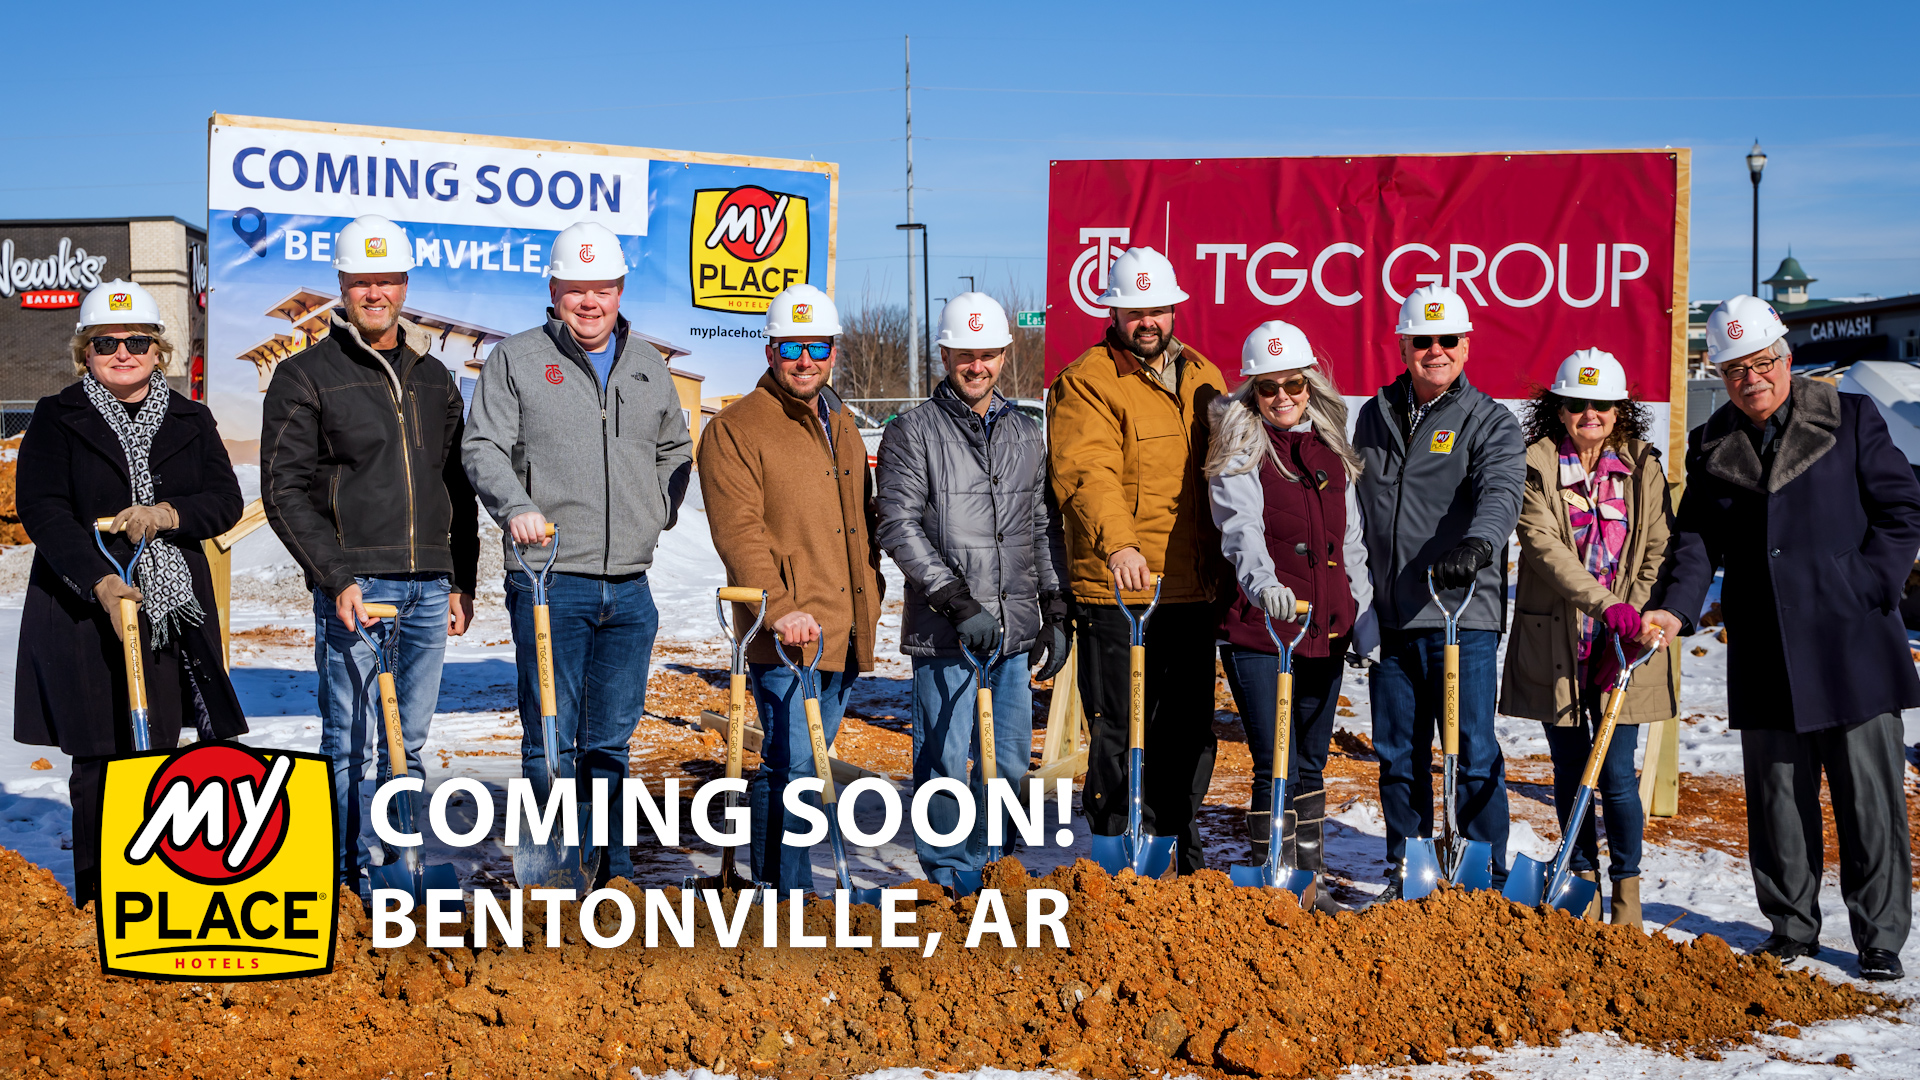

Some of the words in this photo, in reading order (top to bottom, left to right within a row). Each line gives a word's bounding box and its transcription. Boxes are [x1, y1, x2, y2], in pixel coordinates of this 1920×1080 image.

[232, 146, 460, 203] COMING
[475, 164, 621, 213] SOON
[284, 230, 549, 278] BENVILLE,
[699, 263, 799, 293] PLACE
[1196, 242, 1366, 306] TGC
[1380, 242, 1650, 308] GROUP
[26, 294, 75, 305] EATERY
[728, 300, 769, 309] HOTELS
[1810, 321, 1835, 341] CAR
[1835, 315, 1871, 338] WASH
[130, 636, 138, 655] TGC
[539, 645, 547, 663] TGC
[541, 663, 550, 689] GROUP
[1133, 683, 1141, 699] TGC
[391, 709, 400, 724] TGC
[1133, 699, 1141, 723] GROUP
[1279, 711, 1287, 729] TGC
[1447, 703, 1455, 728] GROUP
[393, 724, 403, 749] GROUP
[731, 718, 739, 735] TGC
[729, 735, 738, 763] GROUP
[814, 736, 824, 751] TGC
[817, 752, 828, 777] GROUP
